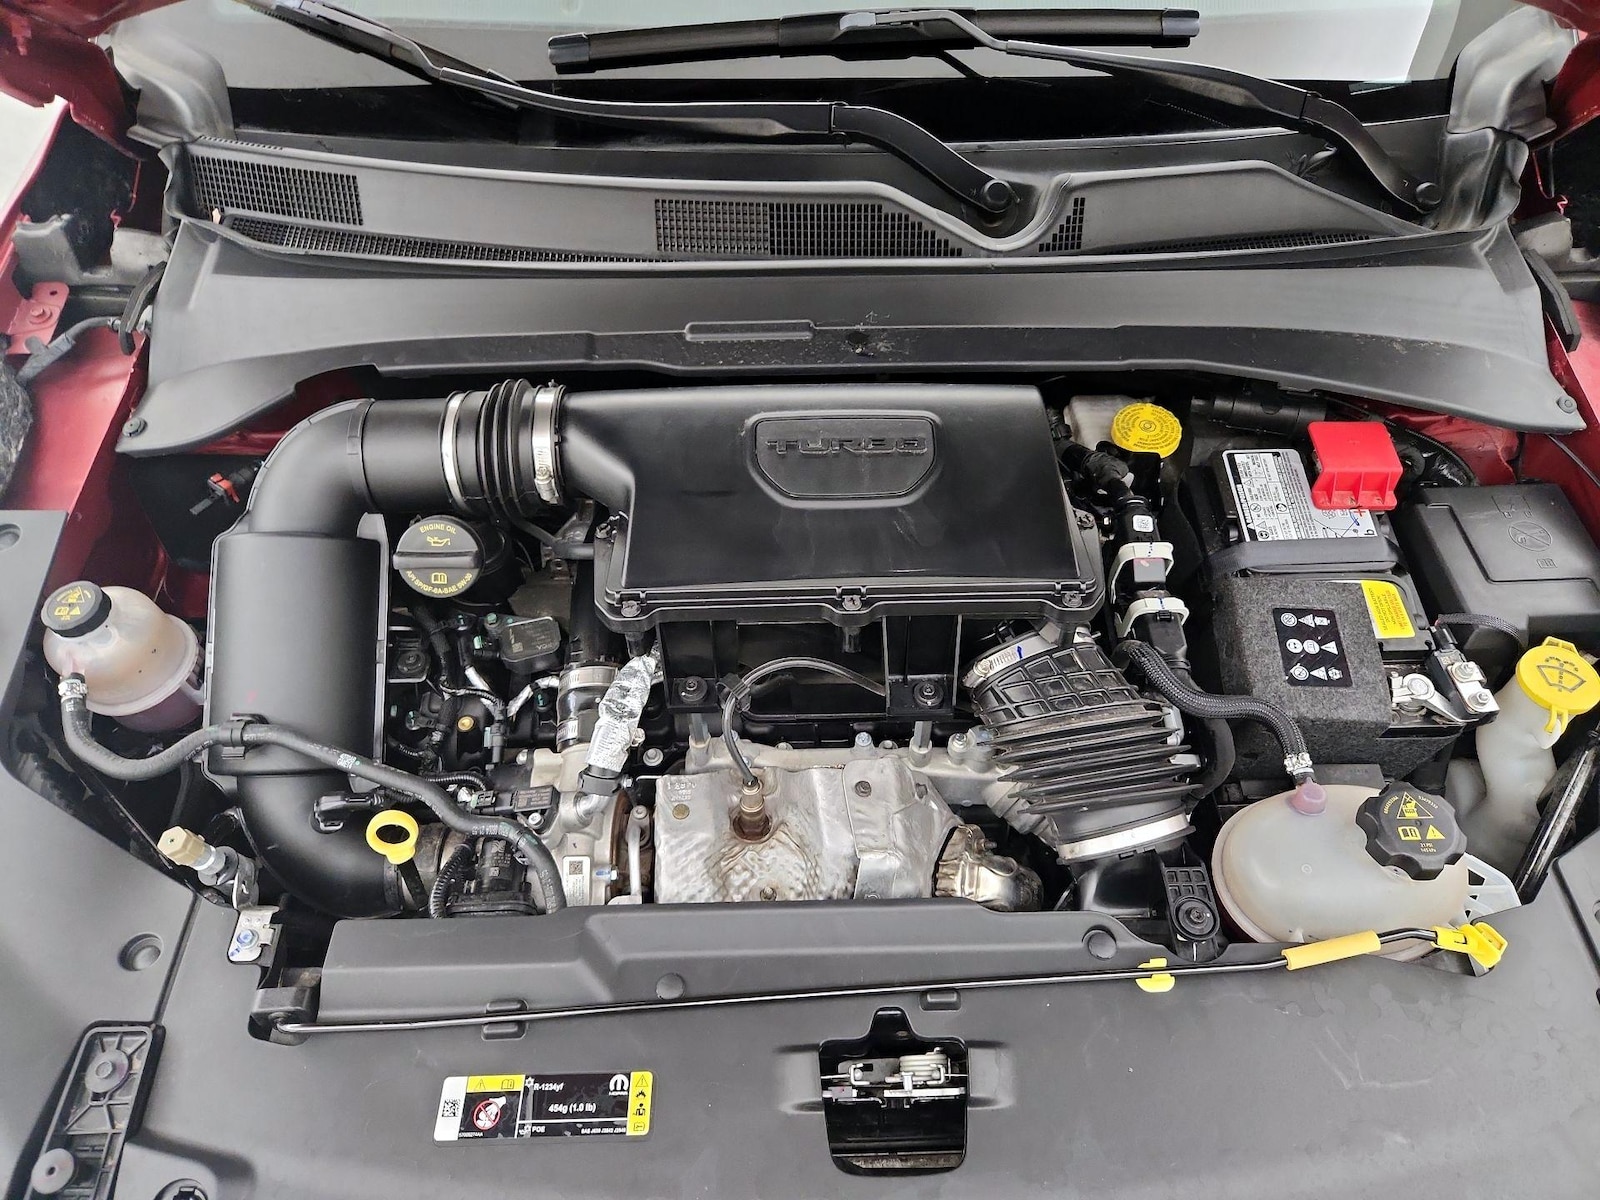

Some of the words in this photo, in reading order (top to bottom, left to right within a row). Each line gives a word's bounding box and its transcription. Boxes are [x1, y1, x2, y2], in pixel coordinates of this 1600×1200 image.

[764, 437, 927, 455] TURBO
[420, 523, 445, 533] ENGINE
[446, 525, 457, 534] OIL
[533, 1081, 564, 1092] R-1234yf
[548, 1103, 568, 1114] 454g
[569, 1102, 584, 1114] (1.0
[585, 1102, 597, 1113] lb)
